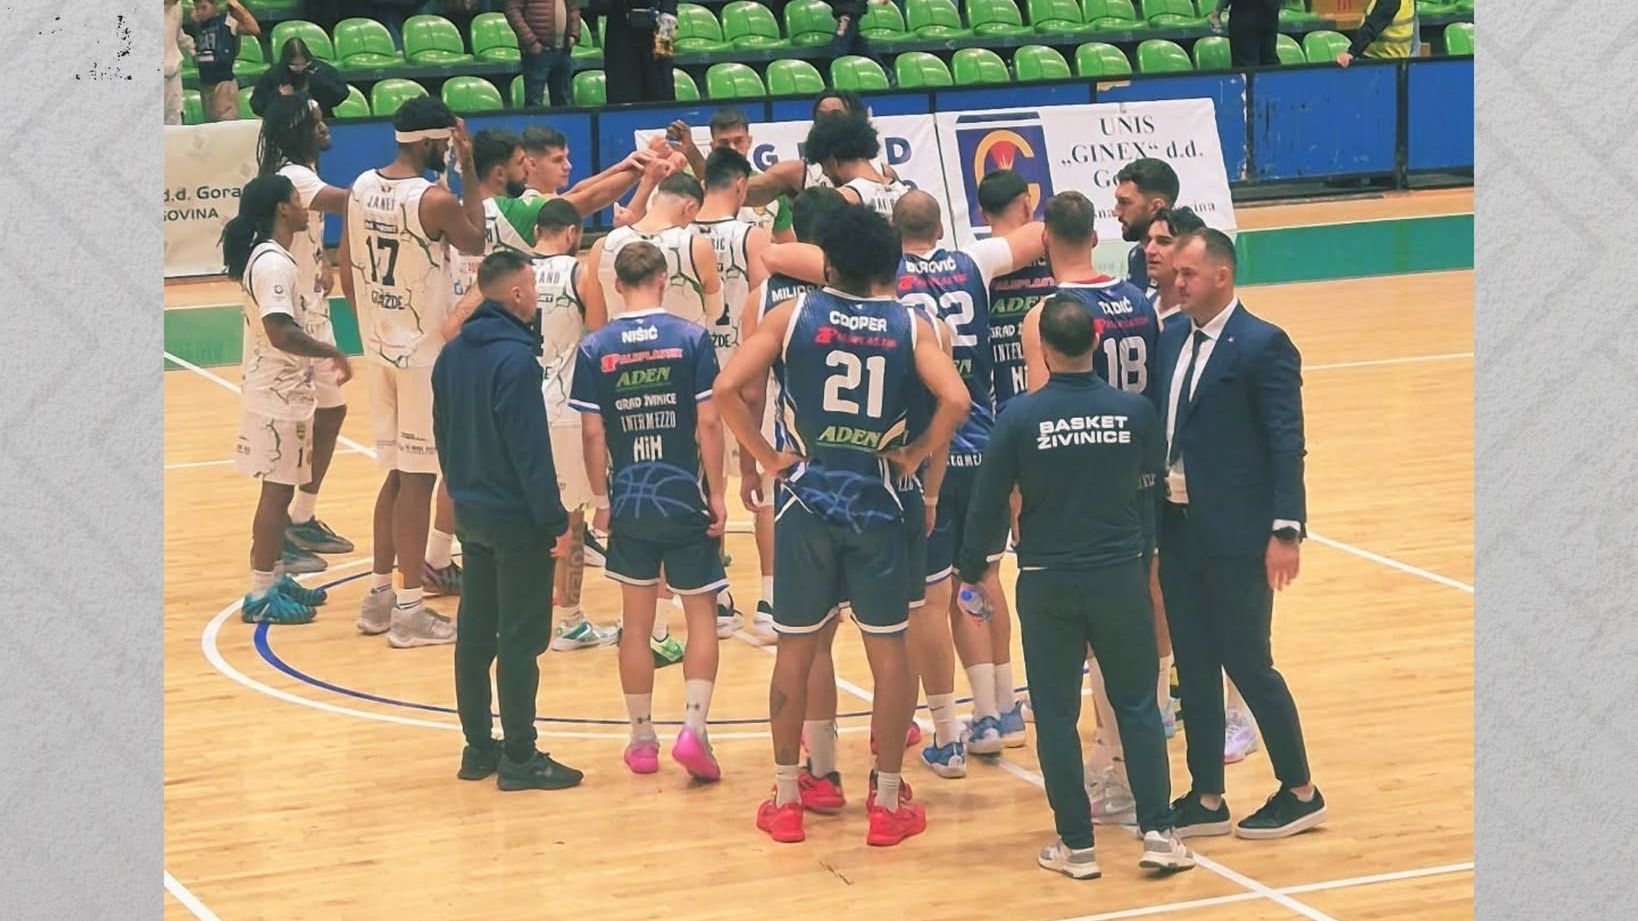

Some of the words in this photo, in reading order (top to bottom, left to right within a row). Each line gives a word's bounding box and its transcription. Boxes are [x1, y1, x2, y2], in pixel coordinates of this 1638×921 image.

[1100, 115, 1155, 137] UNIS
[1166, 140, 1204, 159] d.d.
[366, 236, 400, 286] 17
[829, 310, 888, 333] COOPER
[621, 324, 658, 344] NIŠIĆ
[1103, 335, 1148, 396] 18
[616, 366, 671, 388] ADEN
[822, 349, 886, 419] 21
[615, 397, 642, 411] GRAD
[1038, 415, 1129, 435] BASKET
[818, 425, 882, 448] ADEN
[1036, 430, 1131, 451] ŽIVINICE
